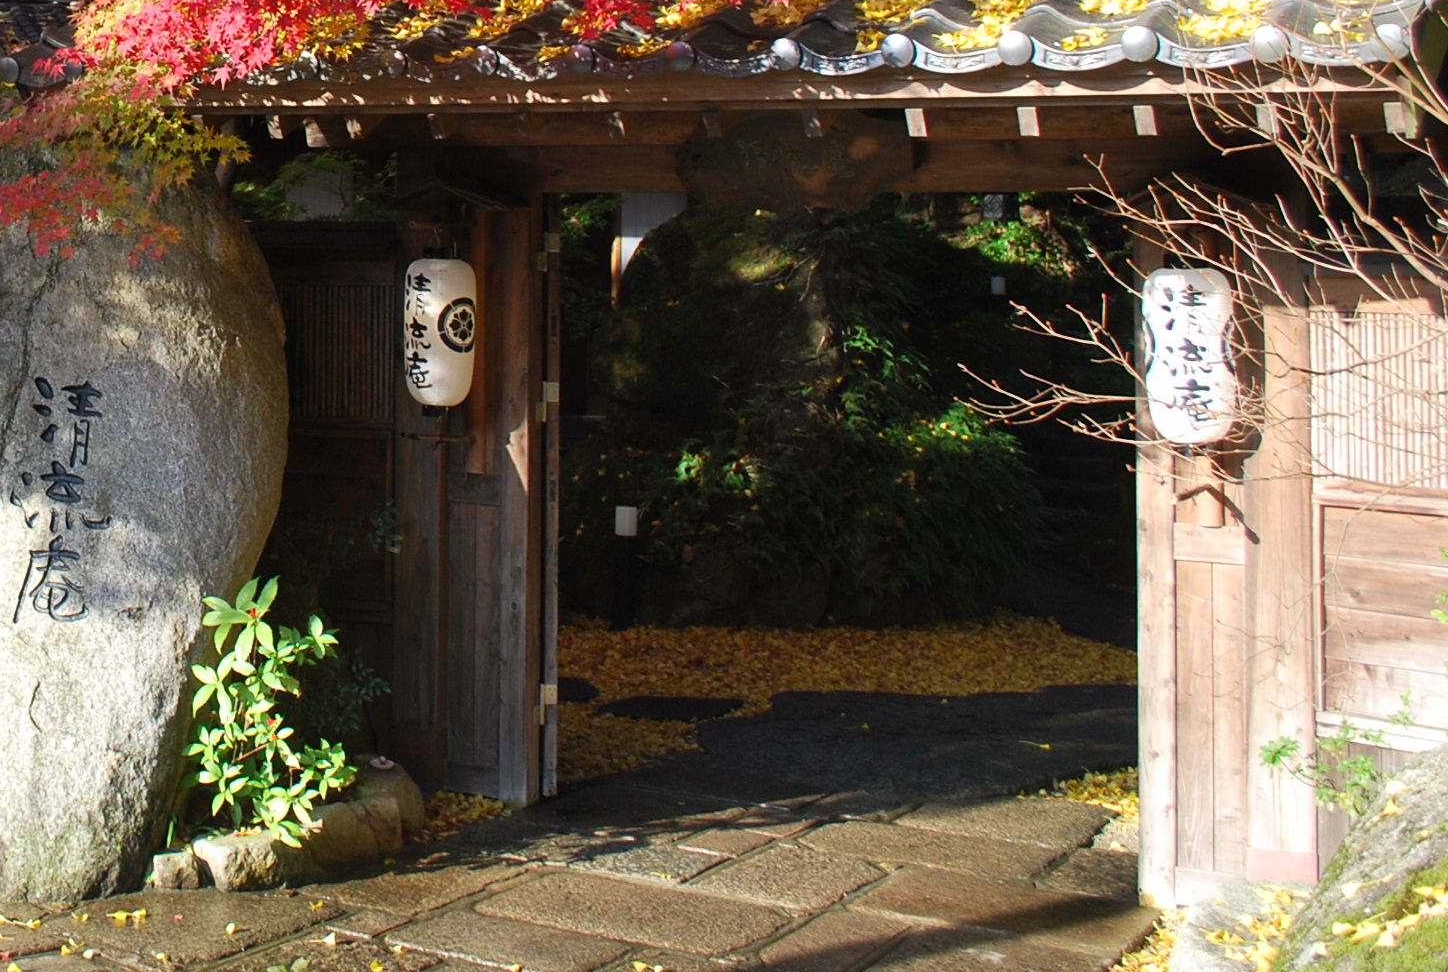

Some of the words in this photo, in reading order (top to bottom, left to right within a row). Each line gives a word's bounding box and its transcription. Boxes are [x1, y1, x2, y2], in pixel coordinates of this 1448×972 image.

[405, 272, 433, 390] 清流庵
[1159, 283, 1213, 430] 清流庵
[9, 376, 112, 624] 清流庵
